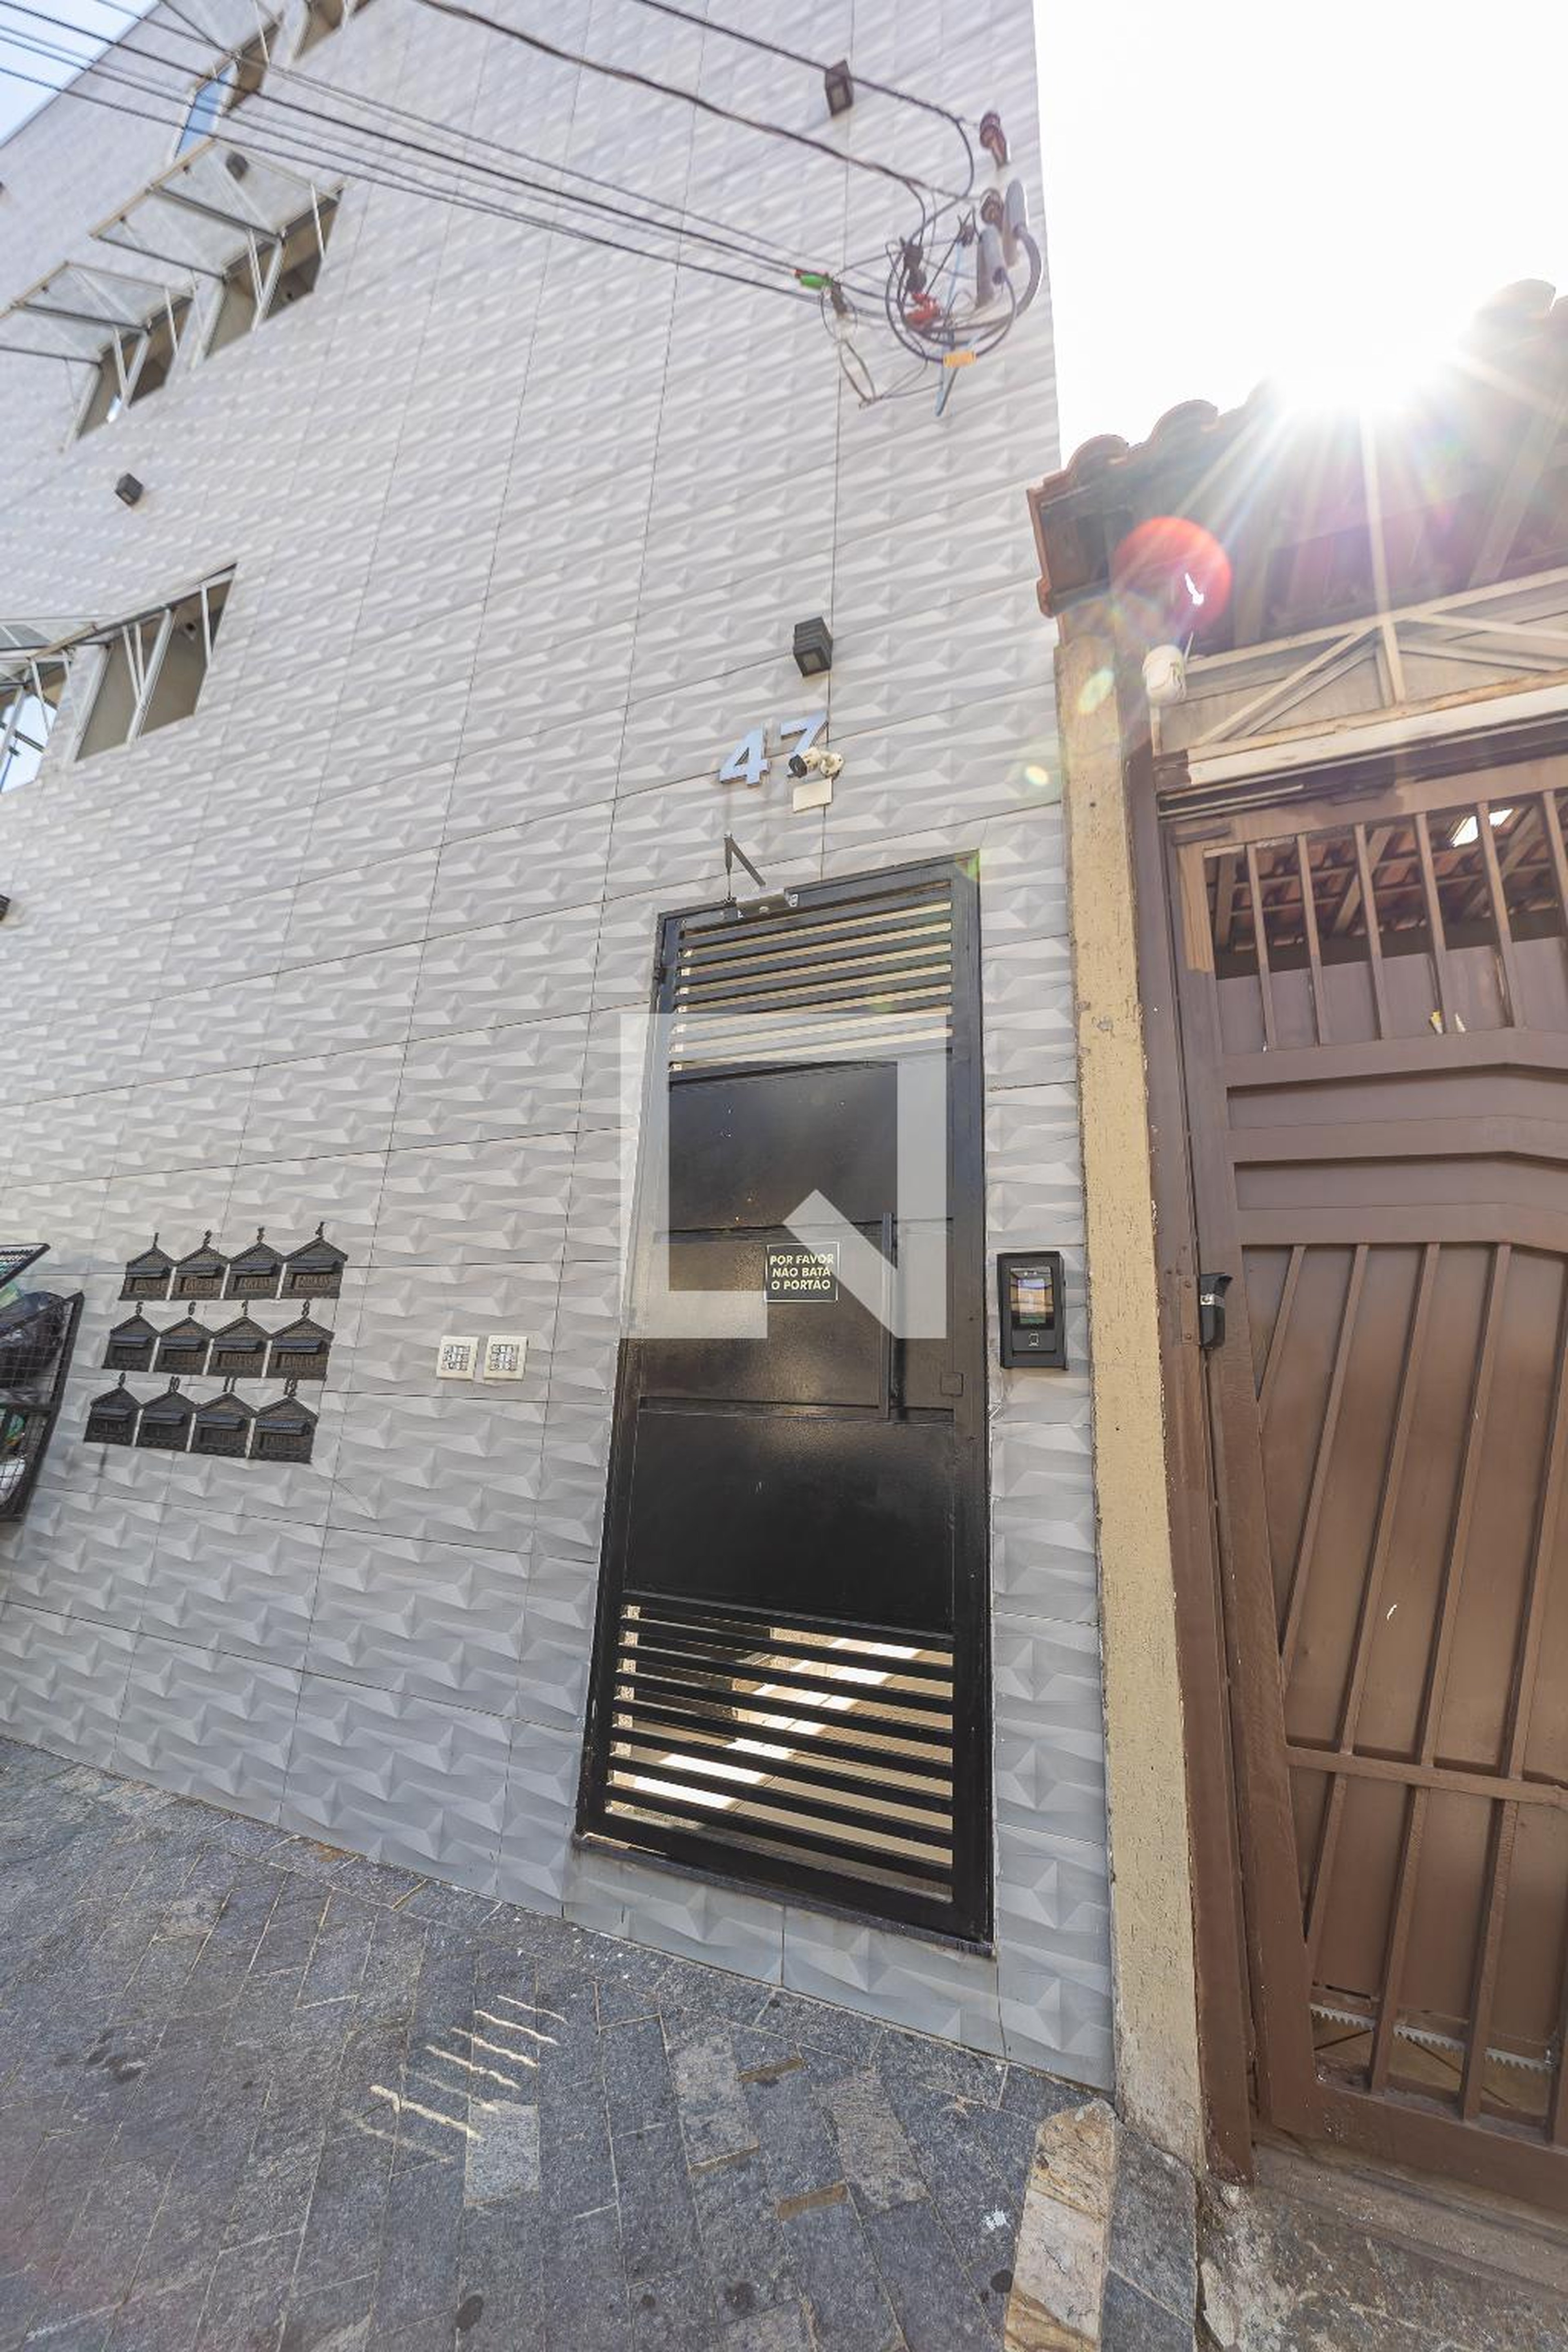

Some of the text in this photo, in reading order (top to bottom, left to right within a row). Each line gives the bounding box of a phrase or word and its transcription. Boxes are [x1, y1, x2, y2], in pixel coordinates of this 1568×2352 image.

[719, 711, 829, 786] 47
[770, 1253, 834, 1265] POR FAVOR
[772, 1264, 831, 1277] NÃO BATA
[771, 1276, 831, 1290] O PORTÃO
[136, 1301, 143, 1315] 5
[188, 1301, 196, 1315] 6
[169, 1376, 180, 1393] 10
[222, 1376, 237, 1392] 11
